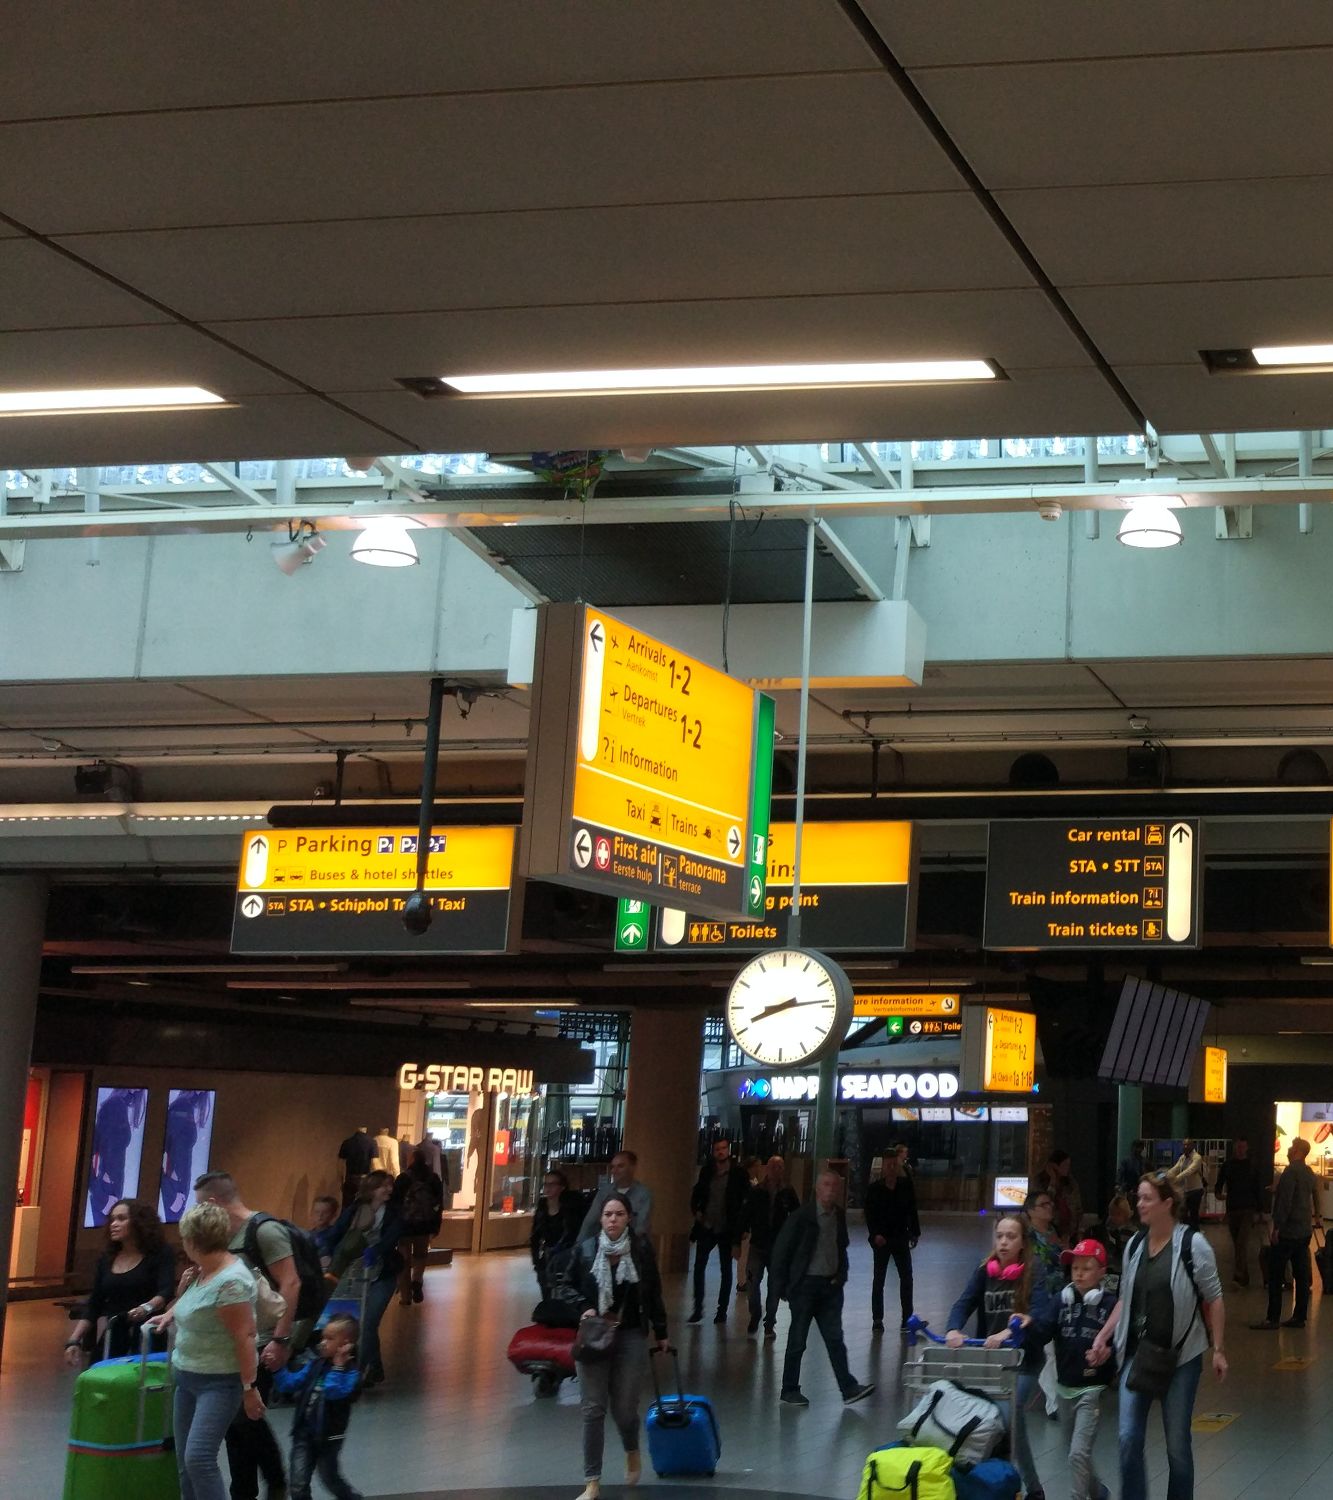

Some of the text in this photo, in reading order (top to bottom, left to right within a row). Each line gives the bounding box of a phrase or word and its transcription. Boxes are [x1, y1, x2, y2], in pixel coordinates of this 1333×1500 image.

[628, 635, 667, 668] Arrivals
[626, 657, 659, 681] Aankomst
[669, 659, 692, 696] 1-2
[623, 684, 678, 723] Departures
[622, 708, 647, 728] Vertrek
[681, 714, 703, 750] 1-2
[619, 744, 678, 782] Information
[626, 799, 698, 838] Taxi Trains
[296, 835, 372, 857] Parking
[1068, 827, 1141, 842] Car rental
[613, 836, 657, 867] First aid
[310, 869, 454, 881] Buses & hotel shttles
[613, 860, 653, 884] Eerste hulp
[679, 854, 727, 884] Panorama
[1069, 860, 1097, 874] STA
[1114, 859, 1141, 873] STT
[679, 878, 702, 895] terrace
[1009, 891, 1046, 905] Train
[1051, 890, 1139, 905] information
[289, 900, 315, 912] STA
[330, 898, 389, 914] Schiphol
[437, 898, 466, 911] Taxi
[730, 926, 777, 938] Toilets
[1048, 922, 1138, 937] Train tickets
[871, 996, 924, 1005] information
[400, 1063, 534, 1093] G-STAR RAW
[841, 1072, 960, 1099] SEAFOOD
